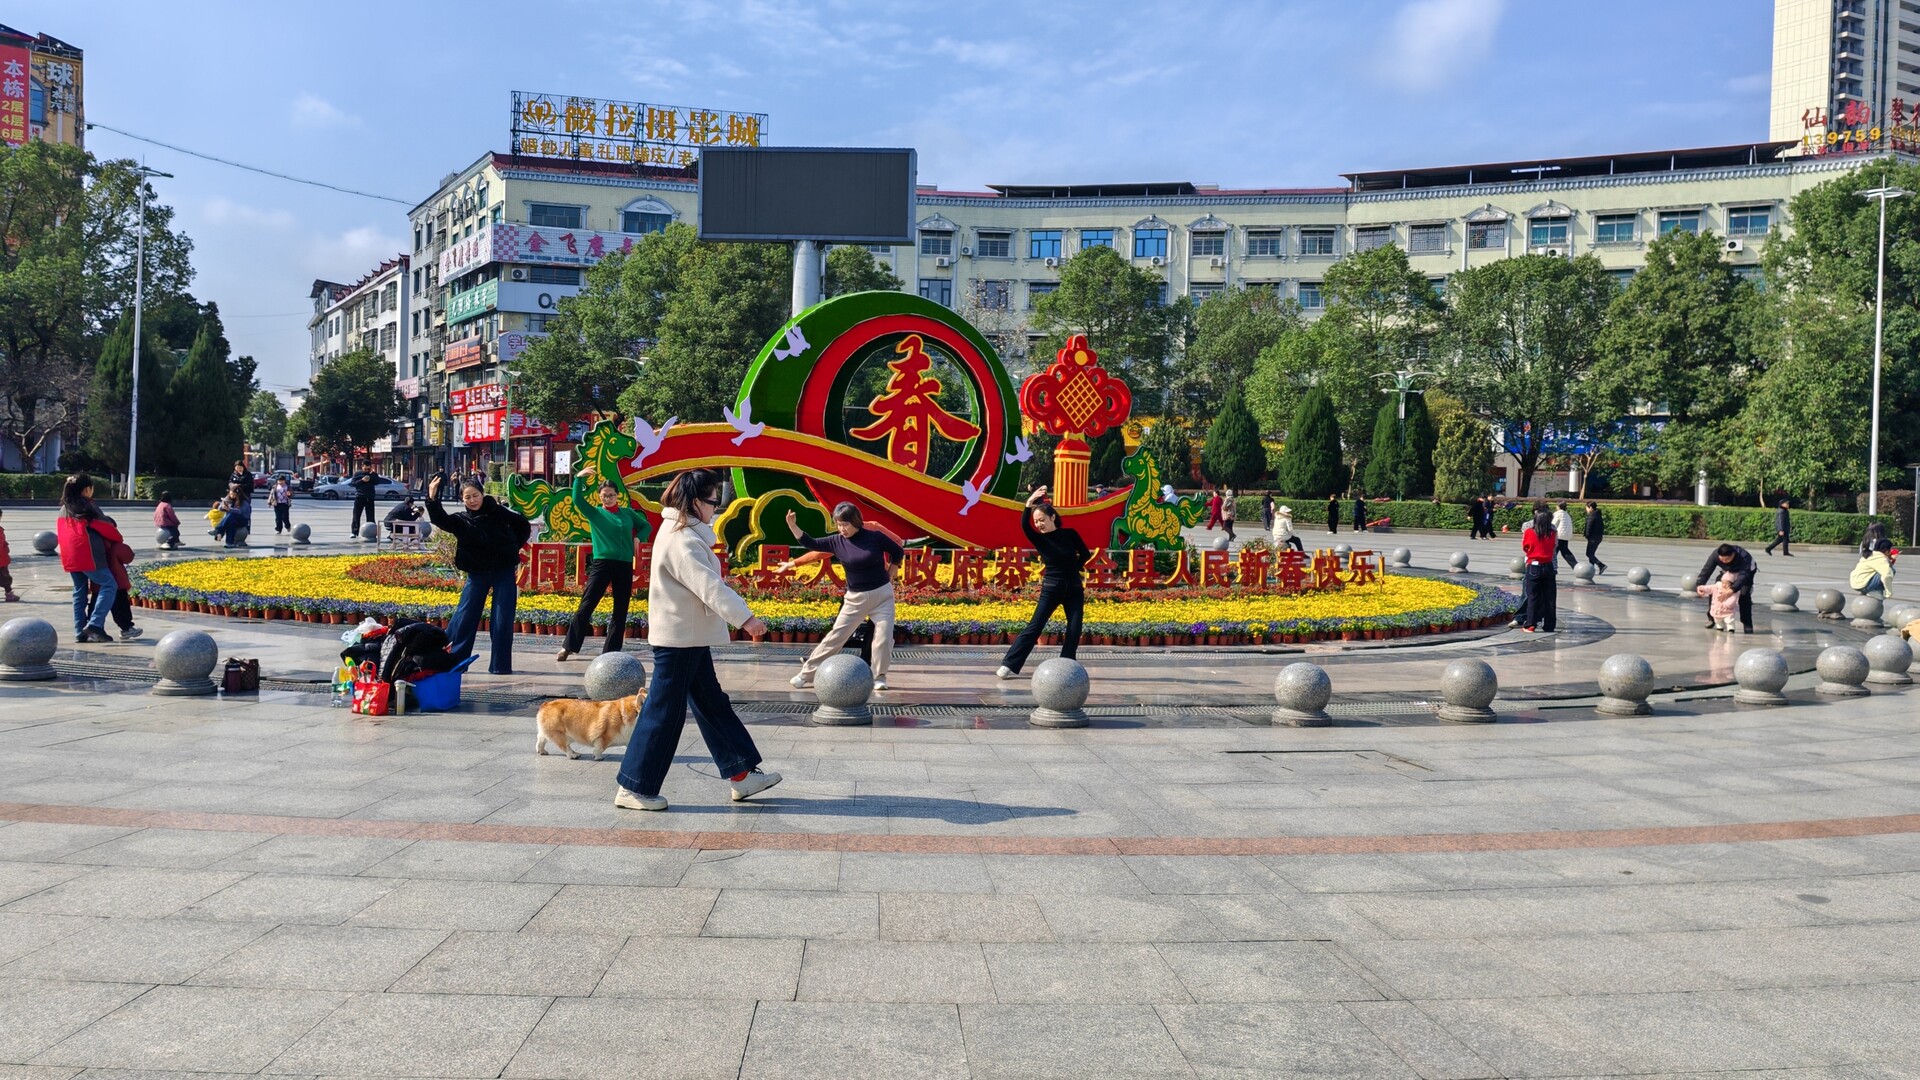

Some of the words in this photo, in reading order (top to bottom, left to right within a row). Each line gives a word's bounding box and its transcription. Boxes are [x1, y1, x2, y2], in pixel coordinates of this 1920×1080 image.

[3, 59, 24, 98] 本栋
[46, 61, 73, 86] 球
[1, 100, 24, 113] 2层
[1, 114, 24, 127] 4层
[1, 128, 24, 141] 6层
[850, 334, 982, 475] 春
